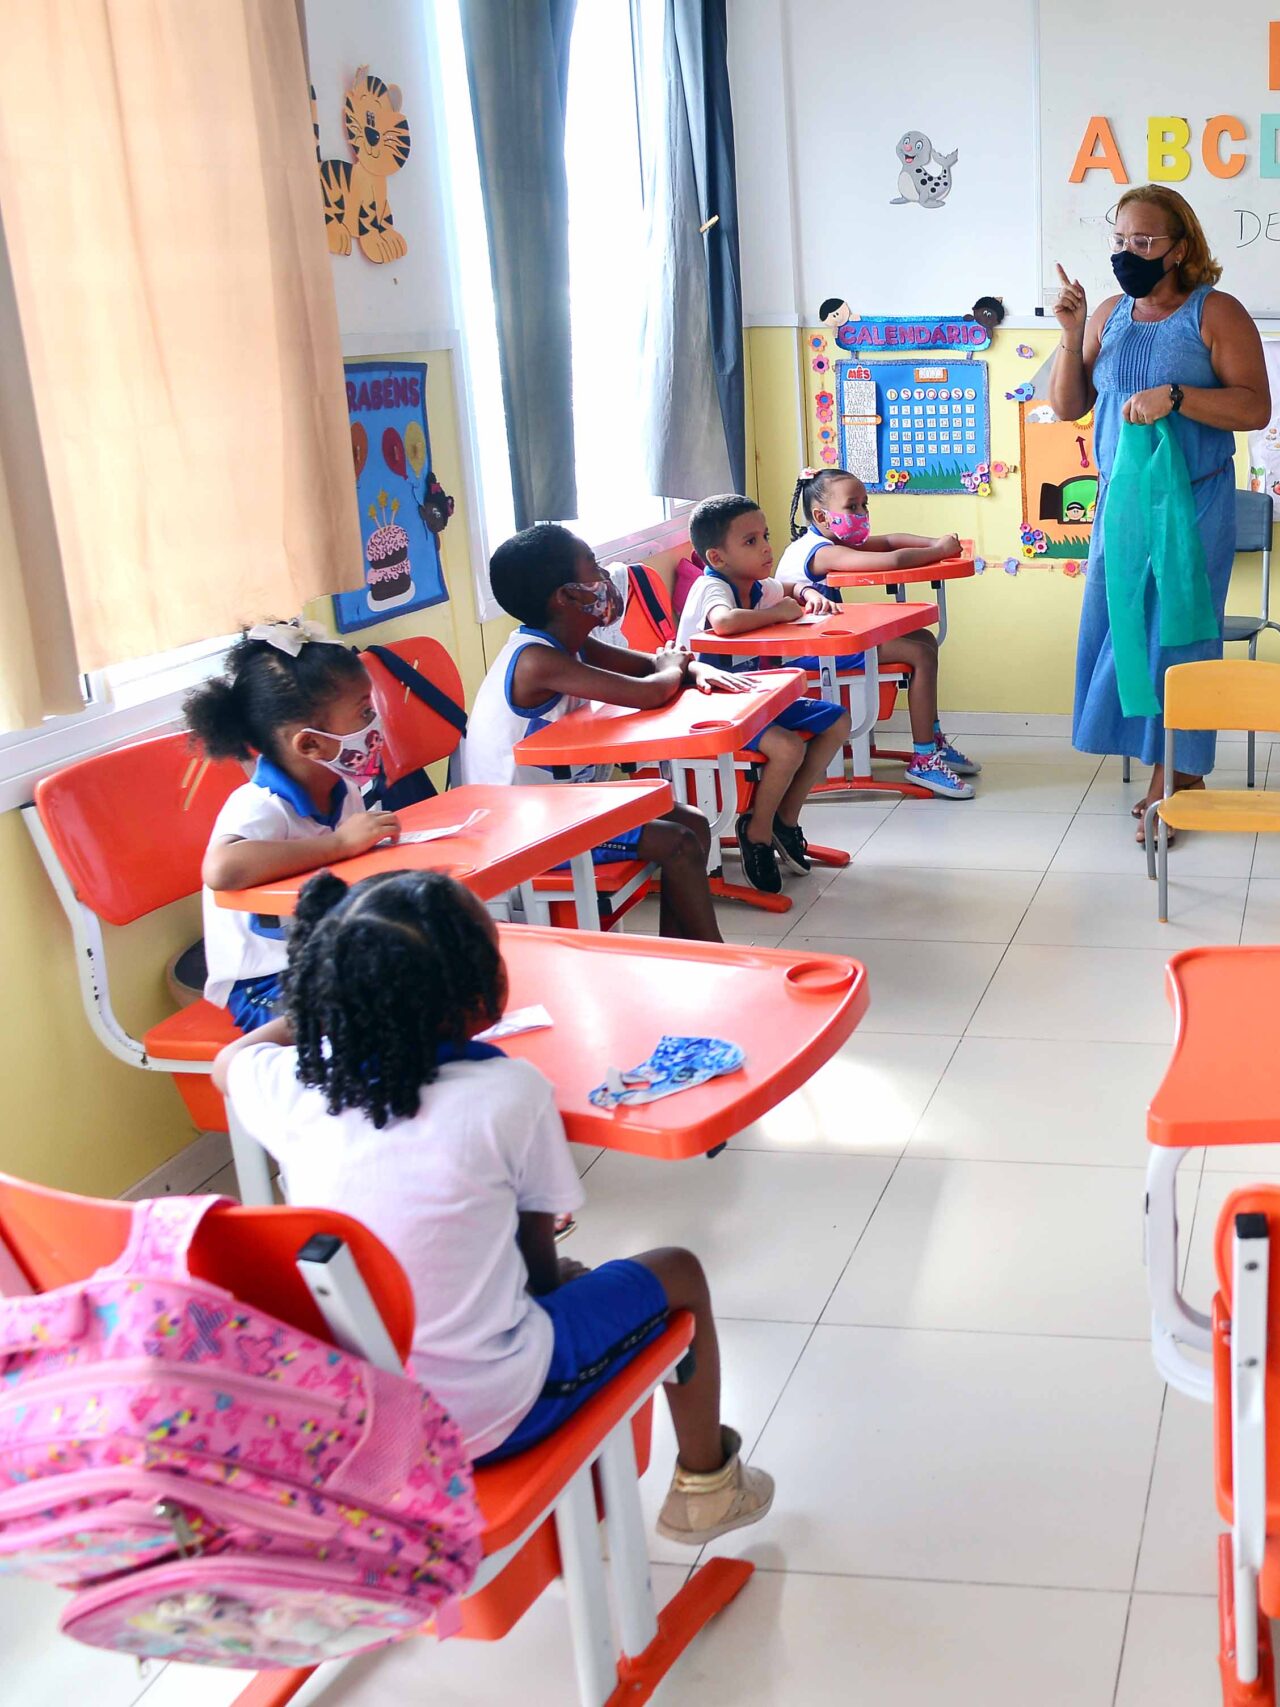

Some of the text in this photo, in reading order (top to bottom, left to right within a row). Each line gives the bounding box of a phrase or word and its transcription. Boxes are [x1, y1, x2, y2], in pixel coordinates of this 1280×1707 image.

[839, 323, 987, 346] CALENDÁRIO
[848, 366, 870, 379] MÊS
[903, 390, 909, 398] S
[954, 389, 960, 398] S
[967, 390, 973, 398] S
